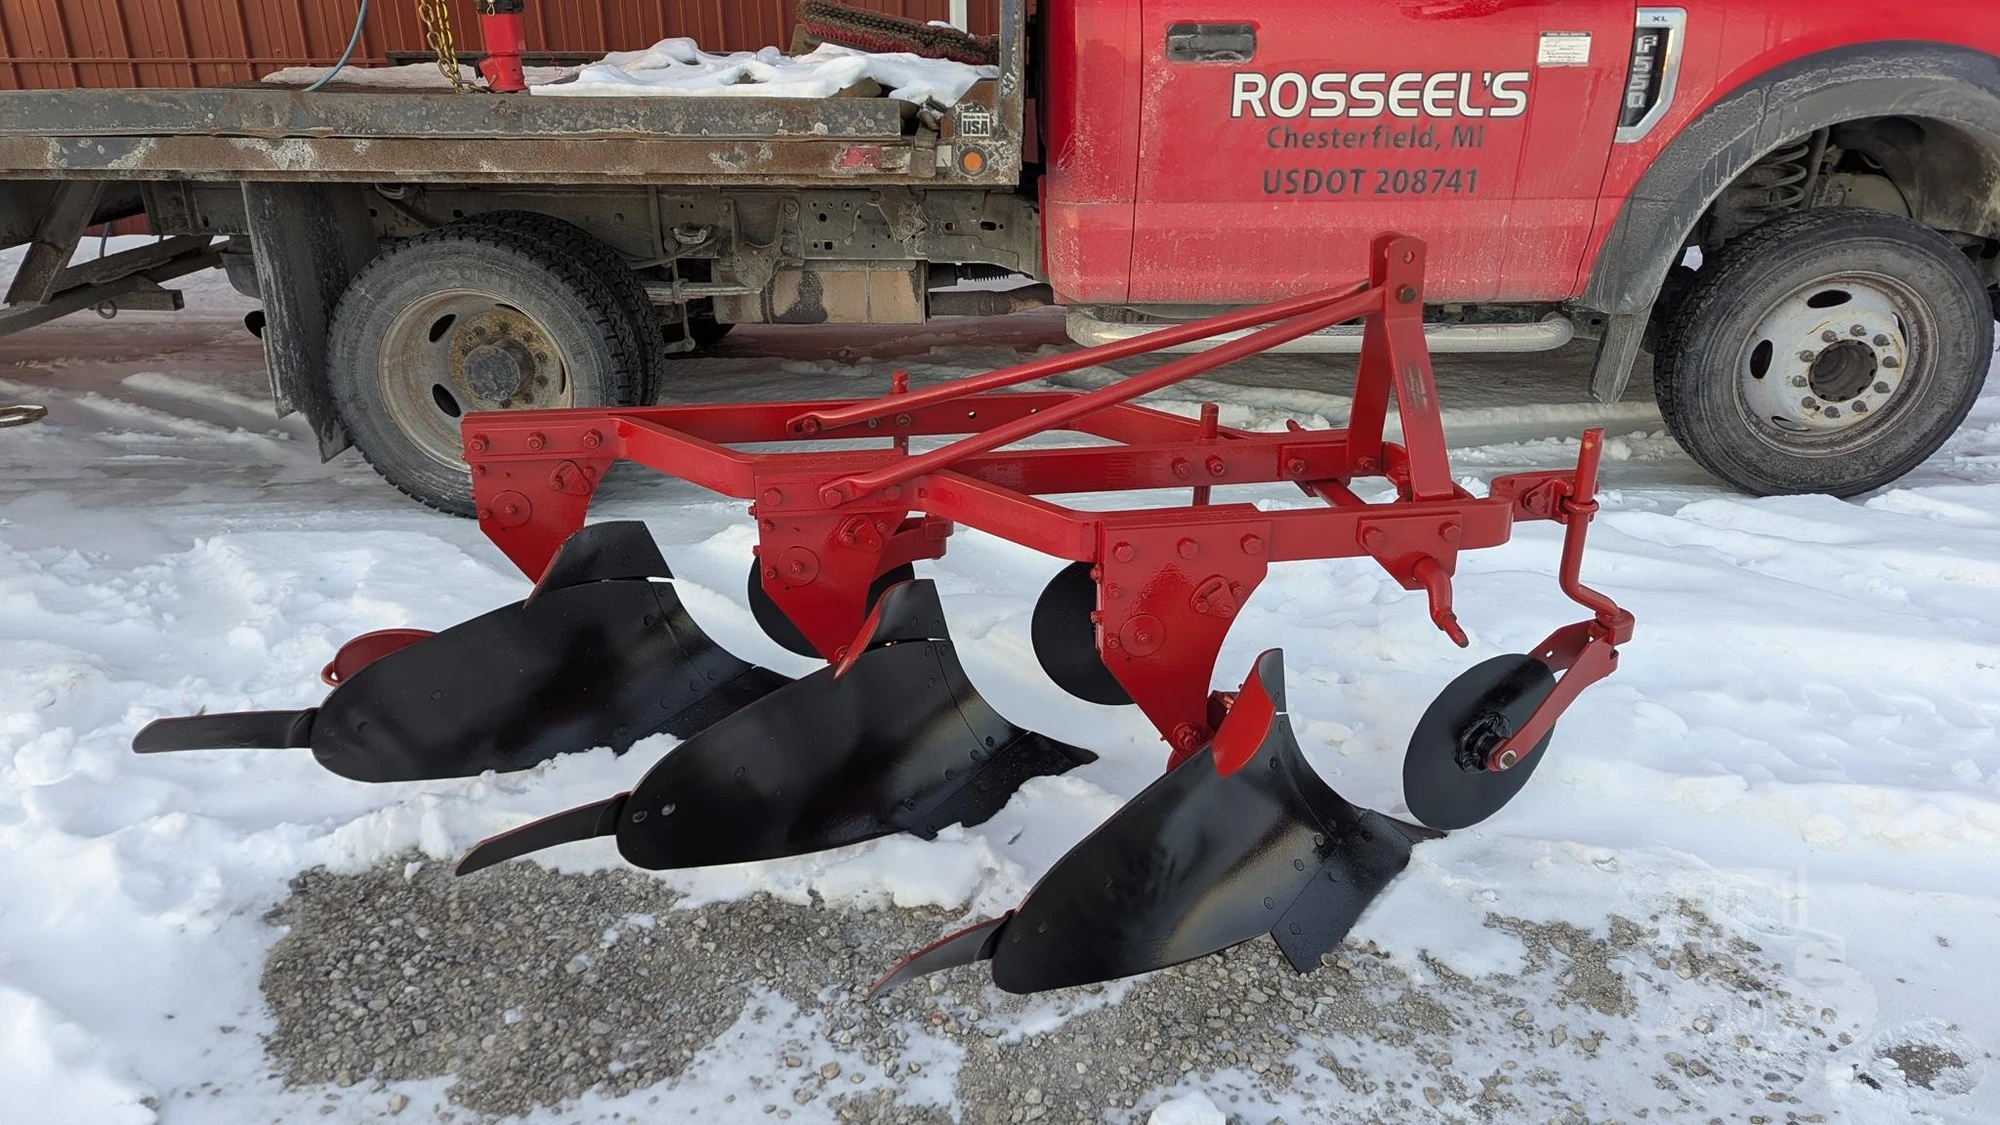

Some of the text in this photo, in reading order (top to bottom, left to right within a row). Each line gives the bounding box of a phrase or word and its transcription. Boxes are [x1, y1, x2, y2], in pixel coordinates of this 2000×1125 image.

[1231, 71, 1530, 118] ROSSEEL'S
[963, 121, 988, 134] USA
[1266, 124, 1485, 151] Chesterfield, MI
[1263, 168, 1478, 194] USDOT 208741
